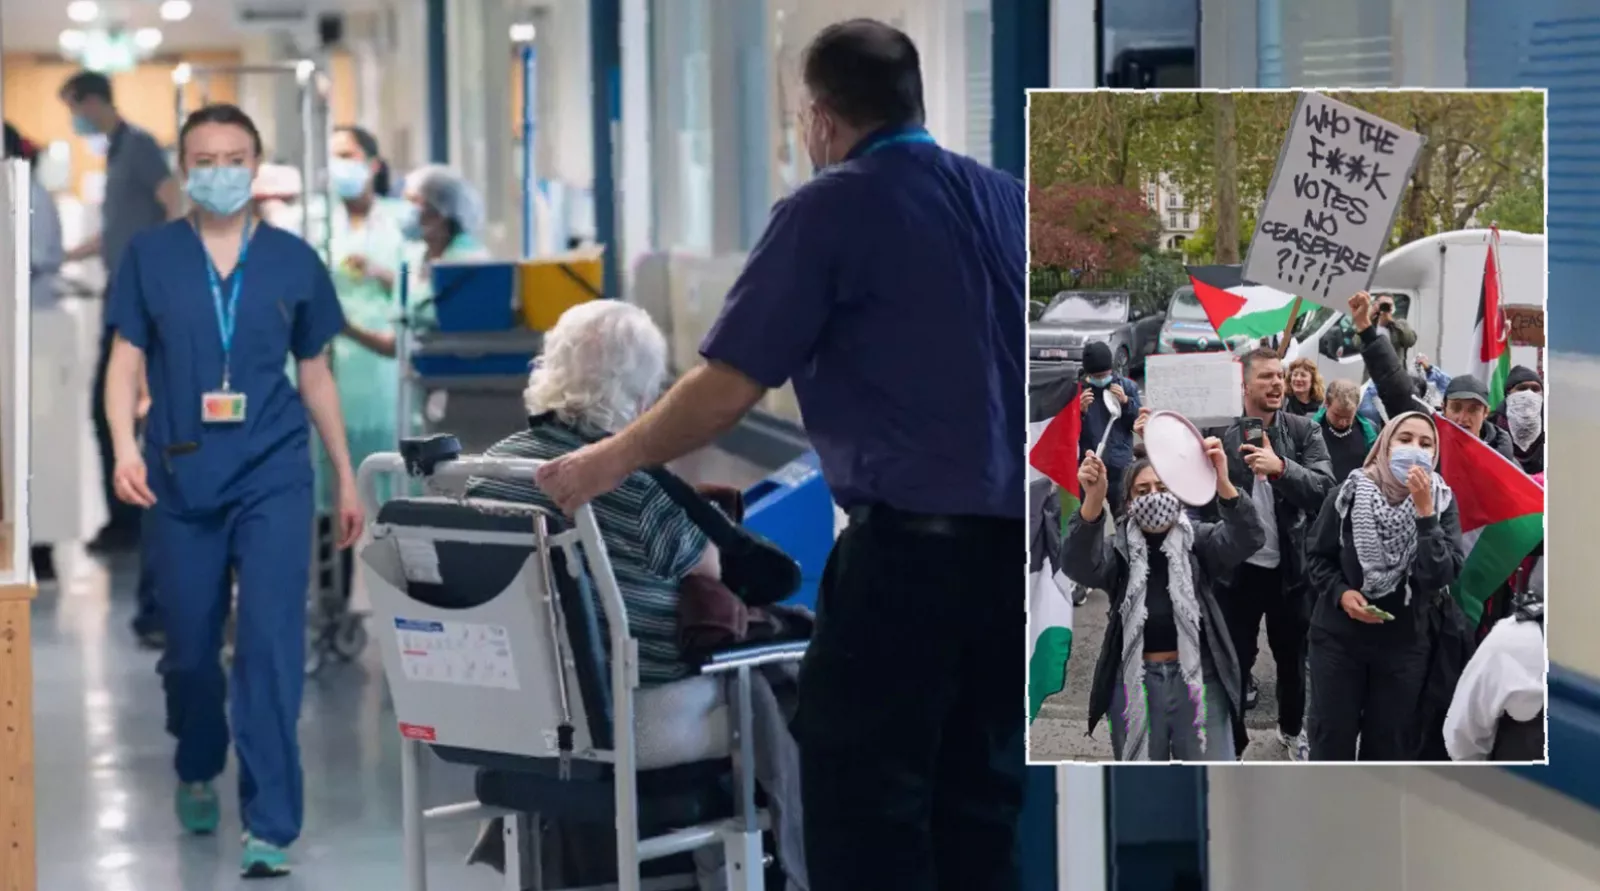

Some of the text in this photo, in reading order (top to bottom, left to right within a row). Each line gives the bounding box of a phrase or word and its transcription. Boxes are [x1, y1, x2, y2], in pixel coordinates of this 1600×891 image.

[1305, 104, 1399, 154] WHO THE
[1294, 173, 1369, 225] VOTES
[1304, 209, 1338, 236] NO
[1261, 221, 1371, 272] CEASEFIRE
